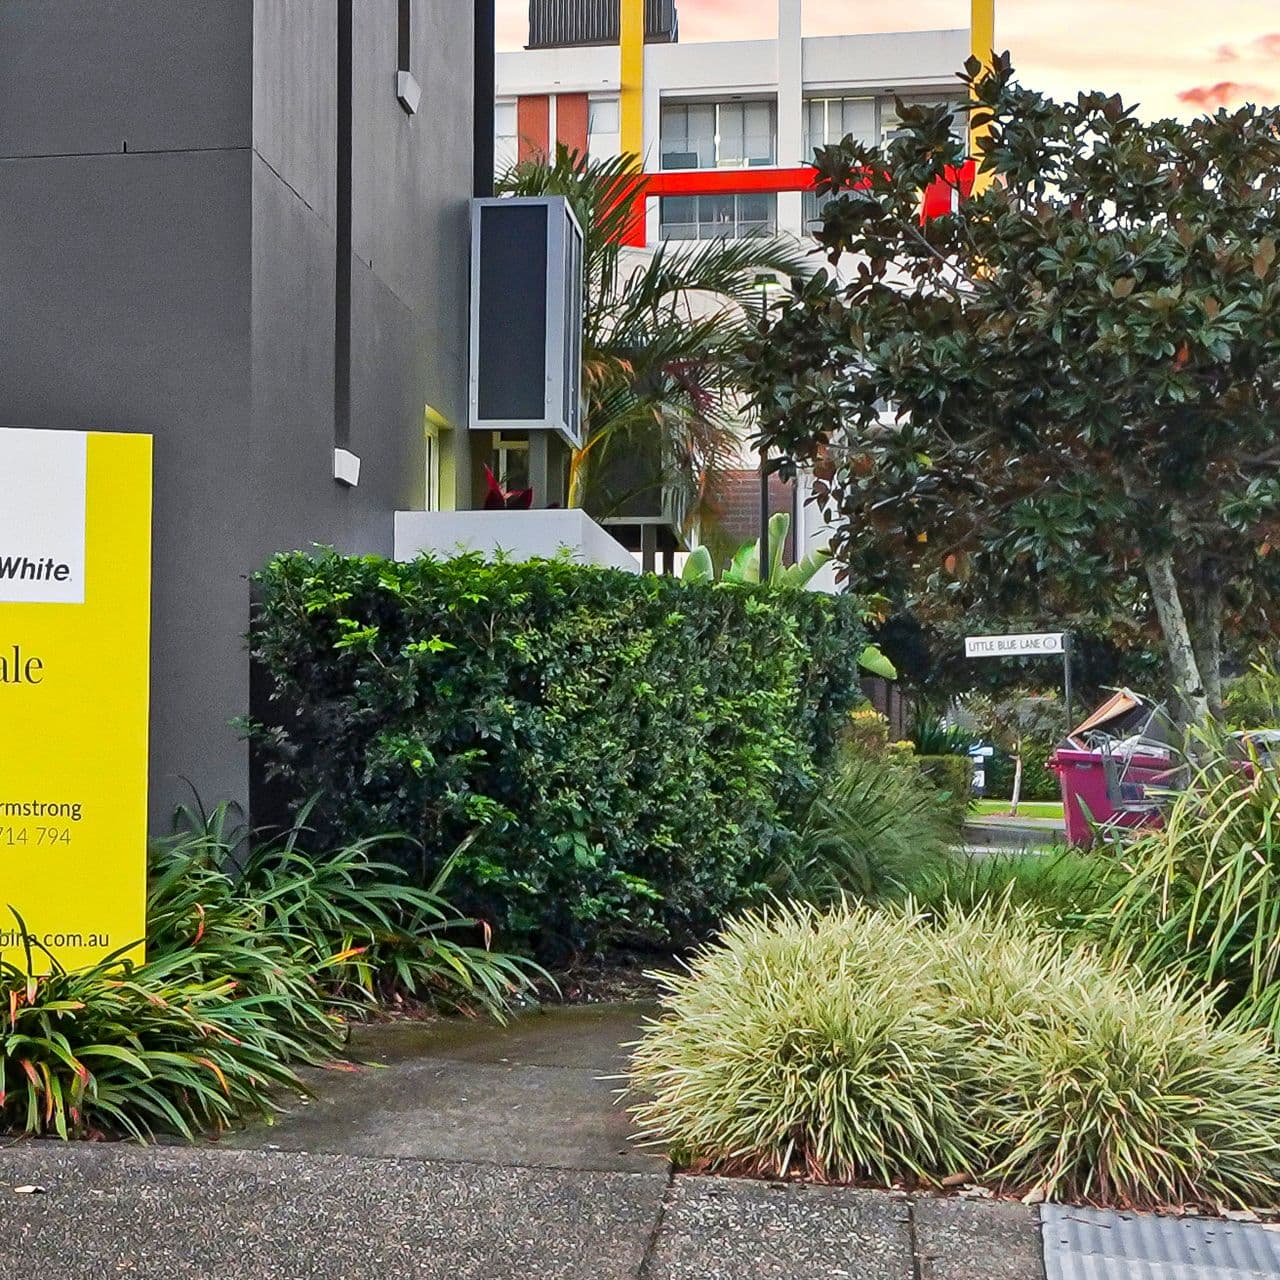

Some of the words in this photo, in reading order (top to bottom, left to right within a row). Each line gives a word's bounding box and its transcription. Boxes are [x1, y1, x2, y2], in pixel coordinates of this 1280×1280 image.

[968, 641, 994, 652] LITTLE
[997, 639, 1017, 650] BLUE
[1020, 638, 1041, 649] LANE
[35, 826, 72, 846] 794
